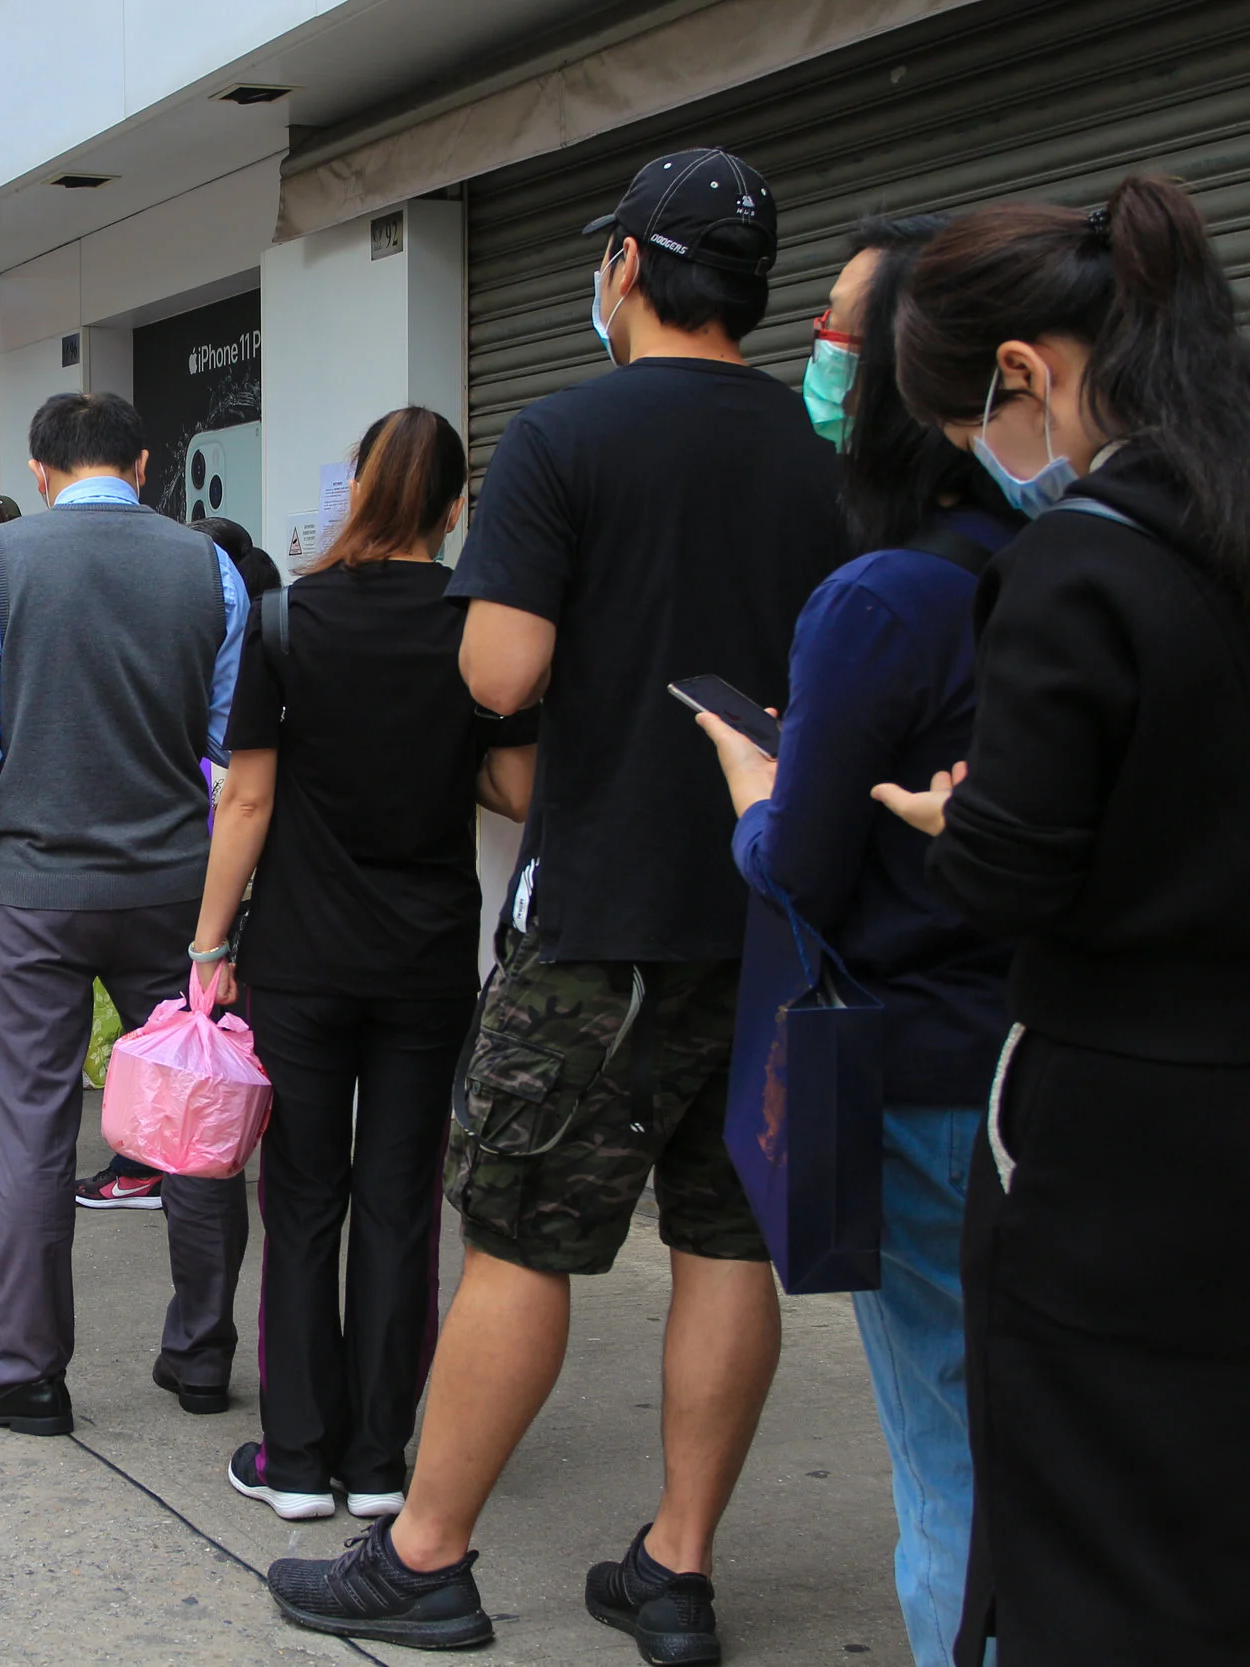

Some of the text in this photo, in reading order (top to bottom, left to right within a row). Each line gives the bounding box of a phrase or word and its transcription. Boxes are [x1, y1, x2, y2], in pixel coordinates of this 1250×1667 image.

[385, 221, 398, 248] 92
[650, 233, 689, 254] DODGERS
[198, 343, 239, 373] iPhone
[239, 332, 250, 361] 11
